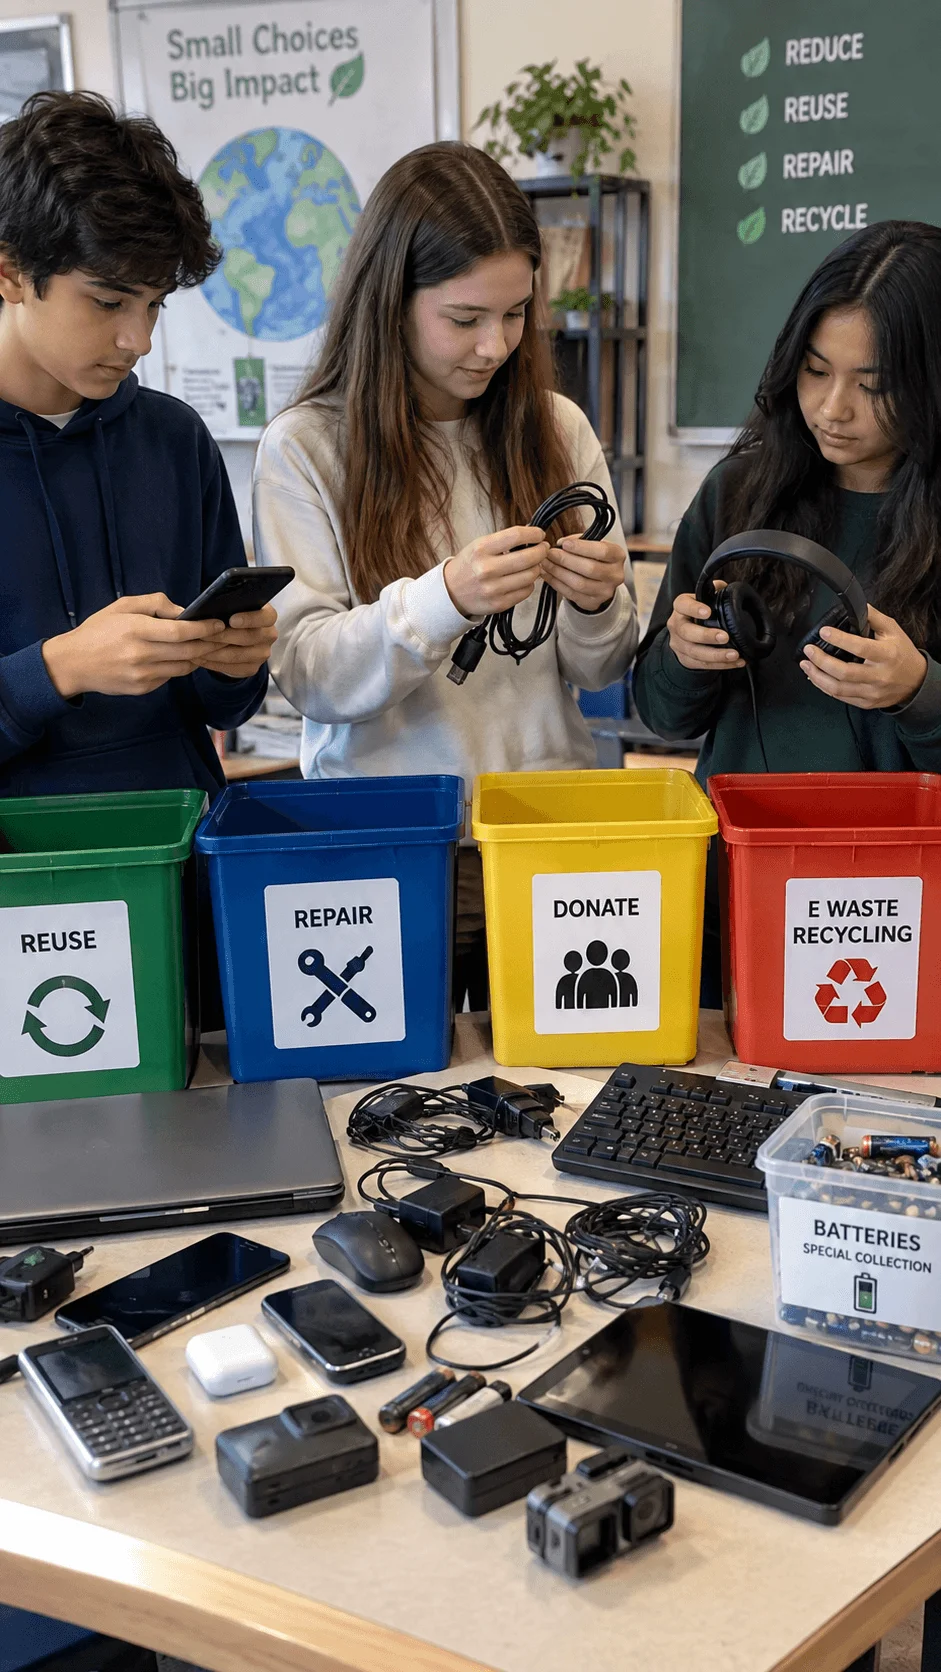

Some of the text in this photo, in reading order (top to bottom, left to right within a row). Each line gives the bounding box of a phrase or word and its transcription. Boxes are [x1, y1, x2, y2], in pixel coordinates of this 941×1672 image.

[167, 22, 359, 60] Small Choices
[786, 33, 863, 65] REDUCE
[170, 65, 320, 110] Big Impact
[785, 92, 848, 123] REUSE
[783, 149, 853, 178] REPAIR
[782, 203, 868, 233] RECYCLE
[295, 906, 373, 928] REPAIR
[554, 898, 639, 918] DONATE
[809, 899, 898, 917] E WASTE
[21, 930, 96, 953] REUSE
[794, 925, 912, 944] RECYCLING
[814, 1219, 921, 1252] BATTERIES
[803, 1242, 932, 1274] SPECIAL COLLECTION
